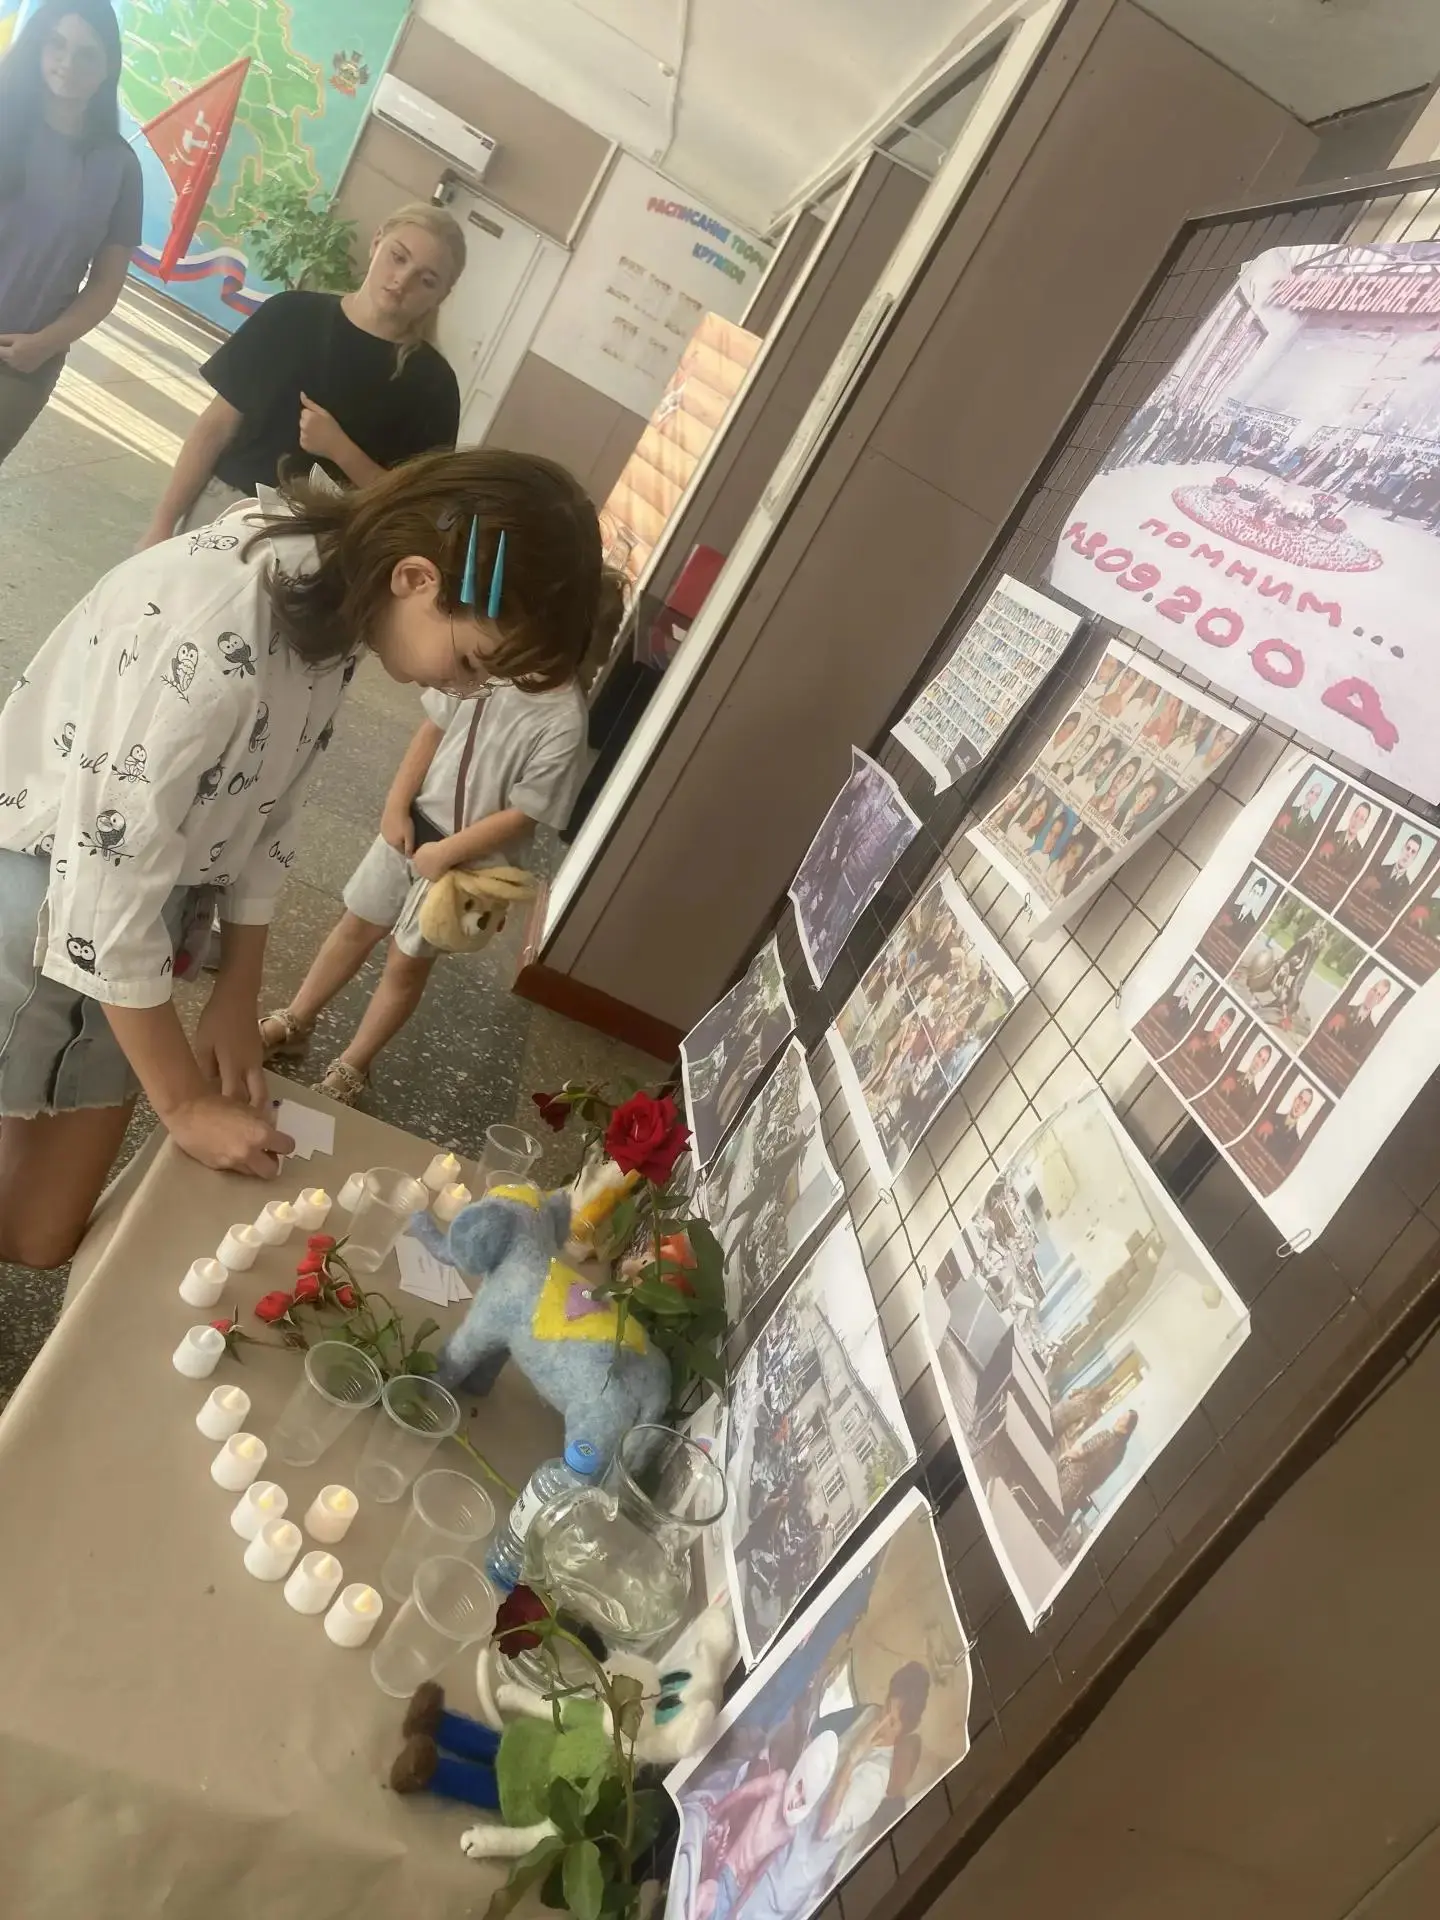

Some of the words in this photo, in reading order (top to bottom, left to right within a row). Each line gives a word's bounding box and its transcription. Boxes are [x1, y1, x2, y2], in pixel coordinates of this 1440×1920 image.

[646, 197, 731, 243] РАСПИСАНИЕ
[692, 242, 746, 285] КРУЖКОВ
[1338, 275, 1433, 313] БЕСЛАНЕ
[228, 760, 263, 796] Owl
[269, 840, 297, 868] Owl
